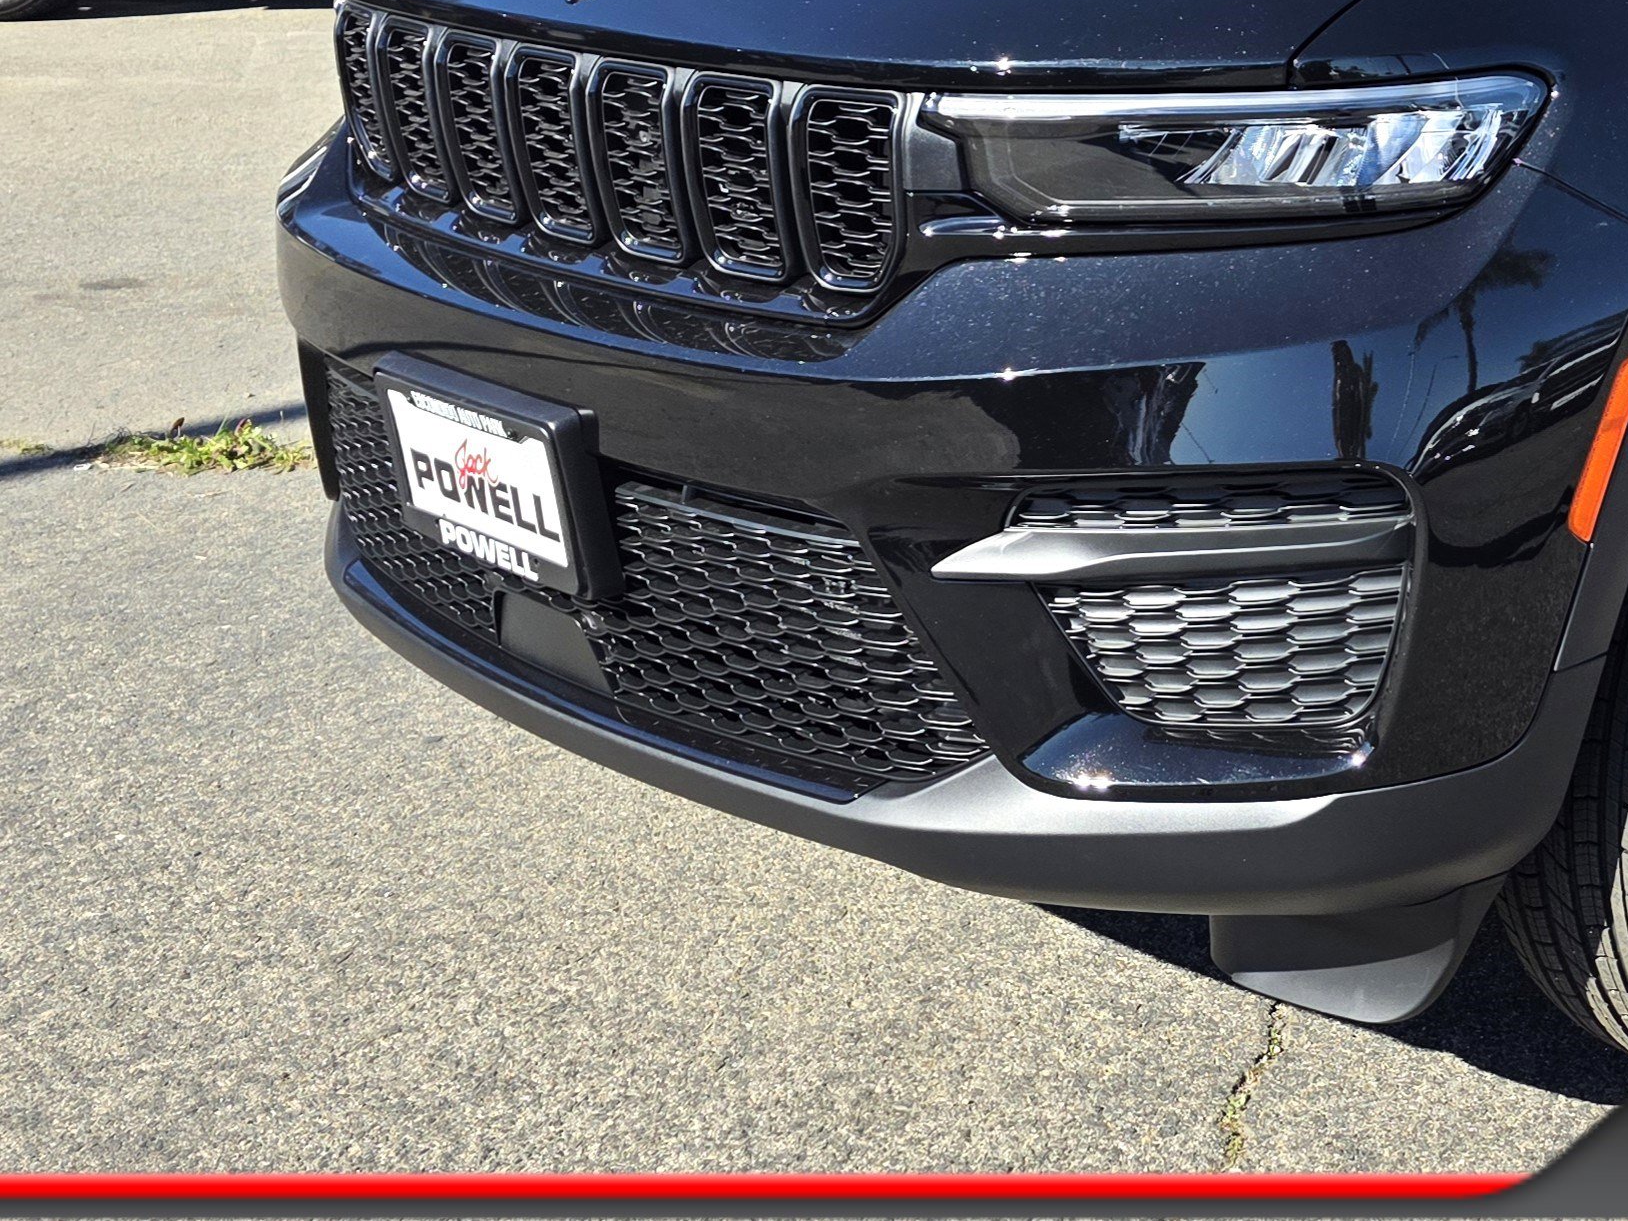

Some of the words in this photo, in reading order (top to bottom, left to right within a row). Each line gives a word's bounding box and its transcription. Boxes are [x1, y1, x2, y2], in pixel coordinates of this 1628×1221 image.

[410, 447, 560, 542] POWELL
[454, 438, 498, 490] Jack
[439, 519, 539, 581] POWELL
